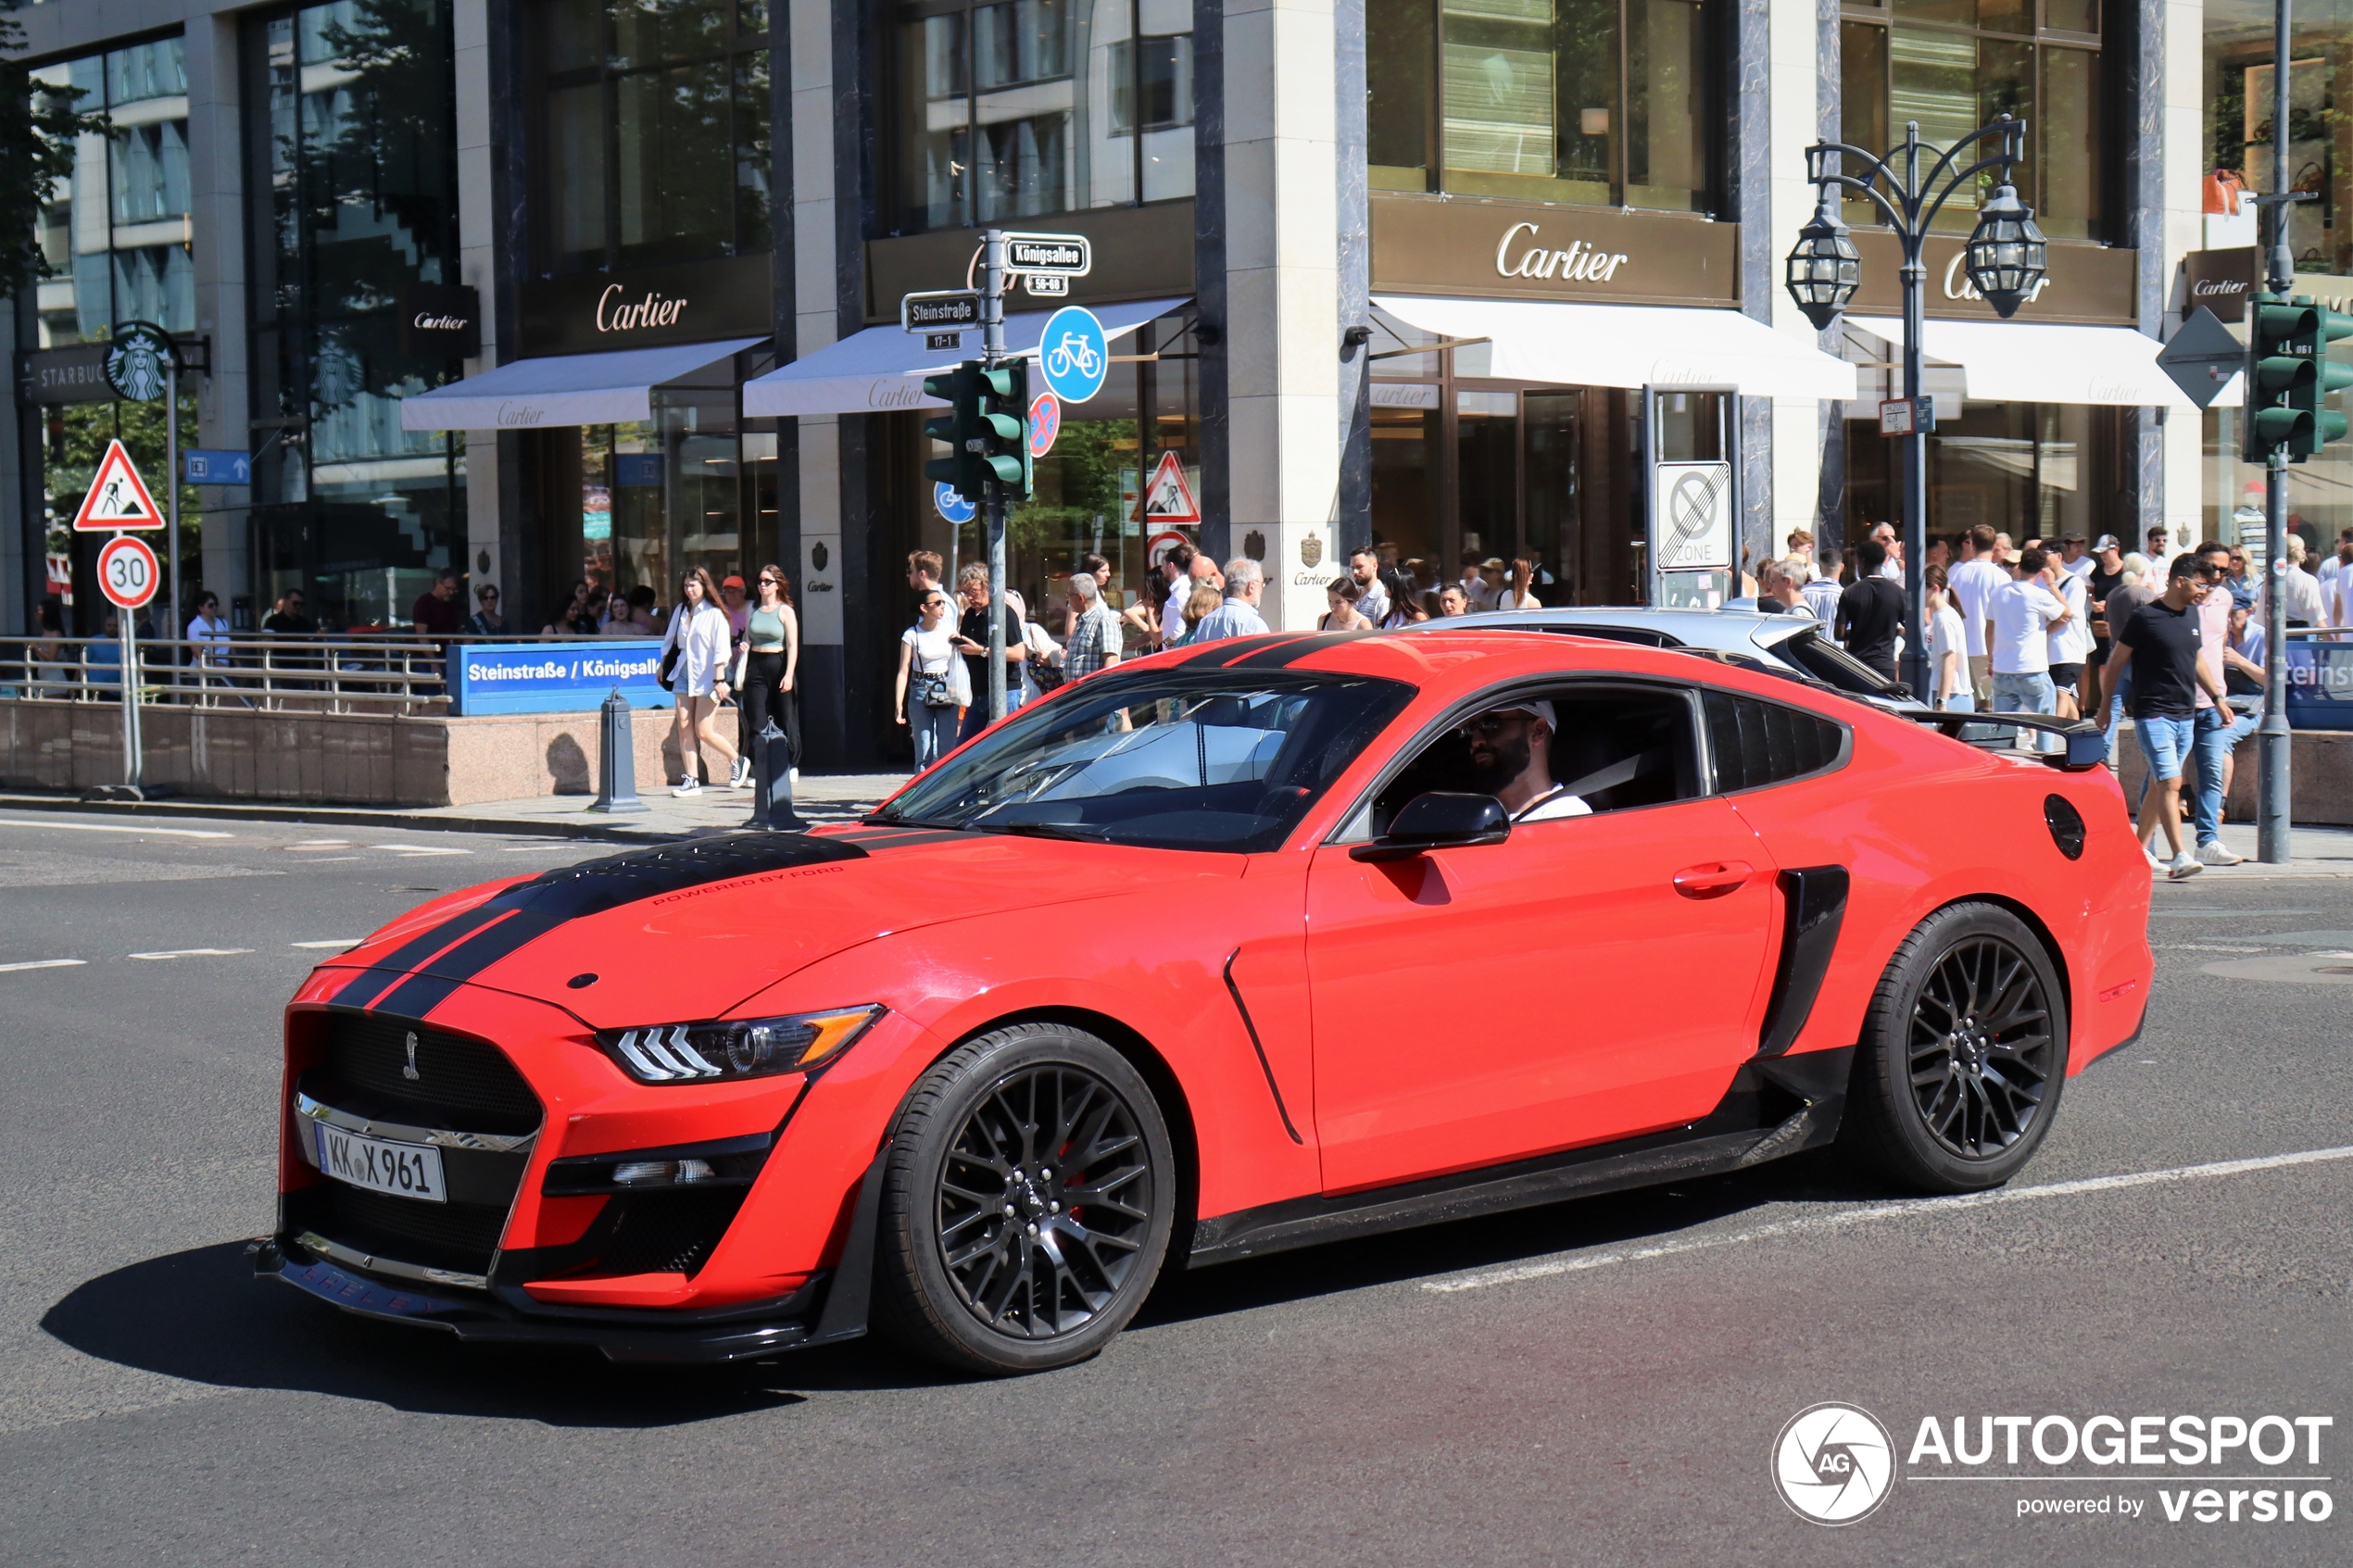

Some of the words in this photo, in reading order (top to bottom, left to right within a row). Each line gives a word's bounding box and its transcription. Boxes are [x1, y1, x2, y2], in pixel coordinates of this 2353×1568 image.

[1015, 244, 1079, 266] Königsallee
[1496, 221, 1629, 282] Cartier
[1035, 279, 1061, 290] 56-68
[2194, 279, 2248, 295] Cartier
[596, 282, 688, 333] Cartier
[912, 301, 972, 321] Steinstraße
[413, 311, 468, 331] Cartier
[934, 335, 951, 346] 17-1
[41, 363, 105, 387] STARBUC
[868, 378, 924, 408] Cartier
[1375, 384, 1431, 405] artier
[2087, 374, 2142, 401] Cartier
[497, 399, 545, 426] Cartier
[1676, 545, 1712, 561] ZONE
[111, 558, 145, 587] 30
[1294, 571, 1332, 585] Cartier
[468, 661, 566, 681] Steinstraße
[571, 660, 578, 679] /
[583, 658, 661, 679] Königsall
[652, 879, 756, 906] POWERED
[760, 873, 785, 883] BY
[789, 866, 844, 878] FORD
